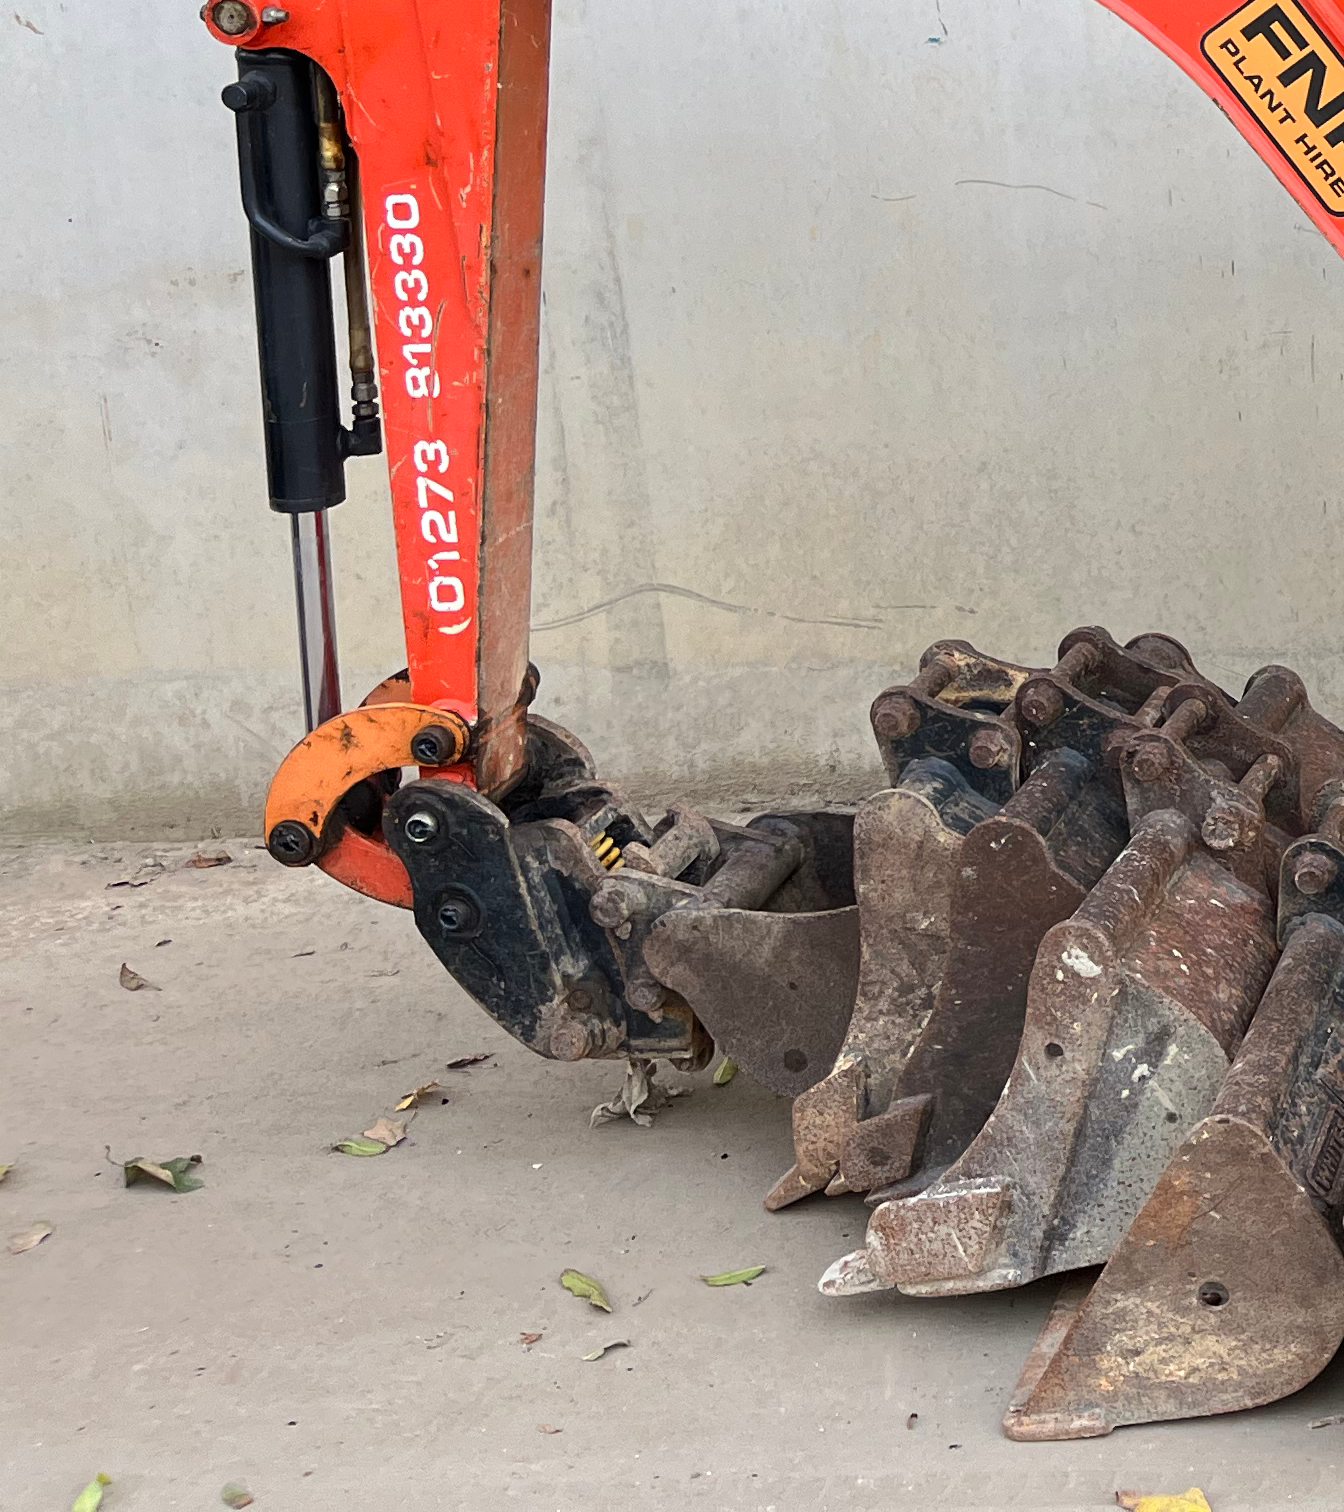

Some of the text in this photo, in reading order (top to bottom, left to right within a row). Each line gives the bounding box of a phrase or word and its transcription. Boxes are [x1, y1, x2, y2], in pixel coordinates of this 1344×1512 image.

[1218, 37, 1297, 125] PLANT
[385, 193, 471, 636] (01273 813330
